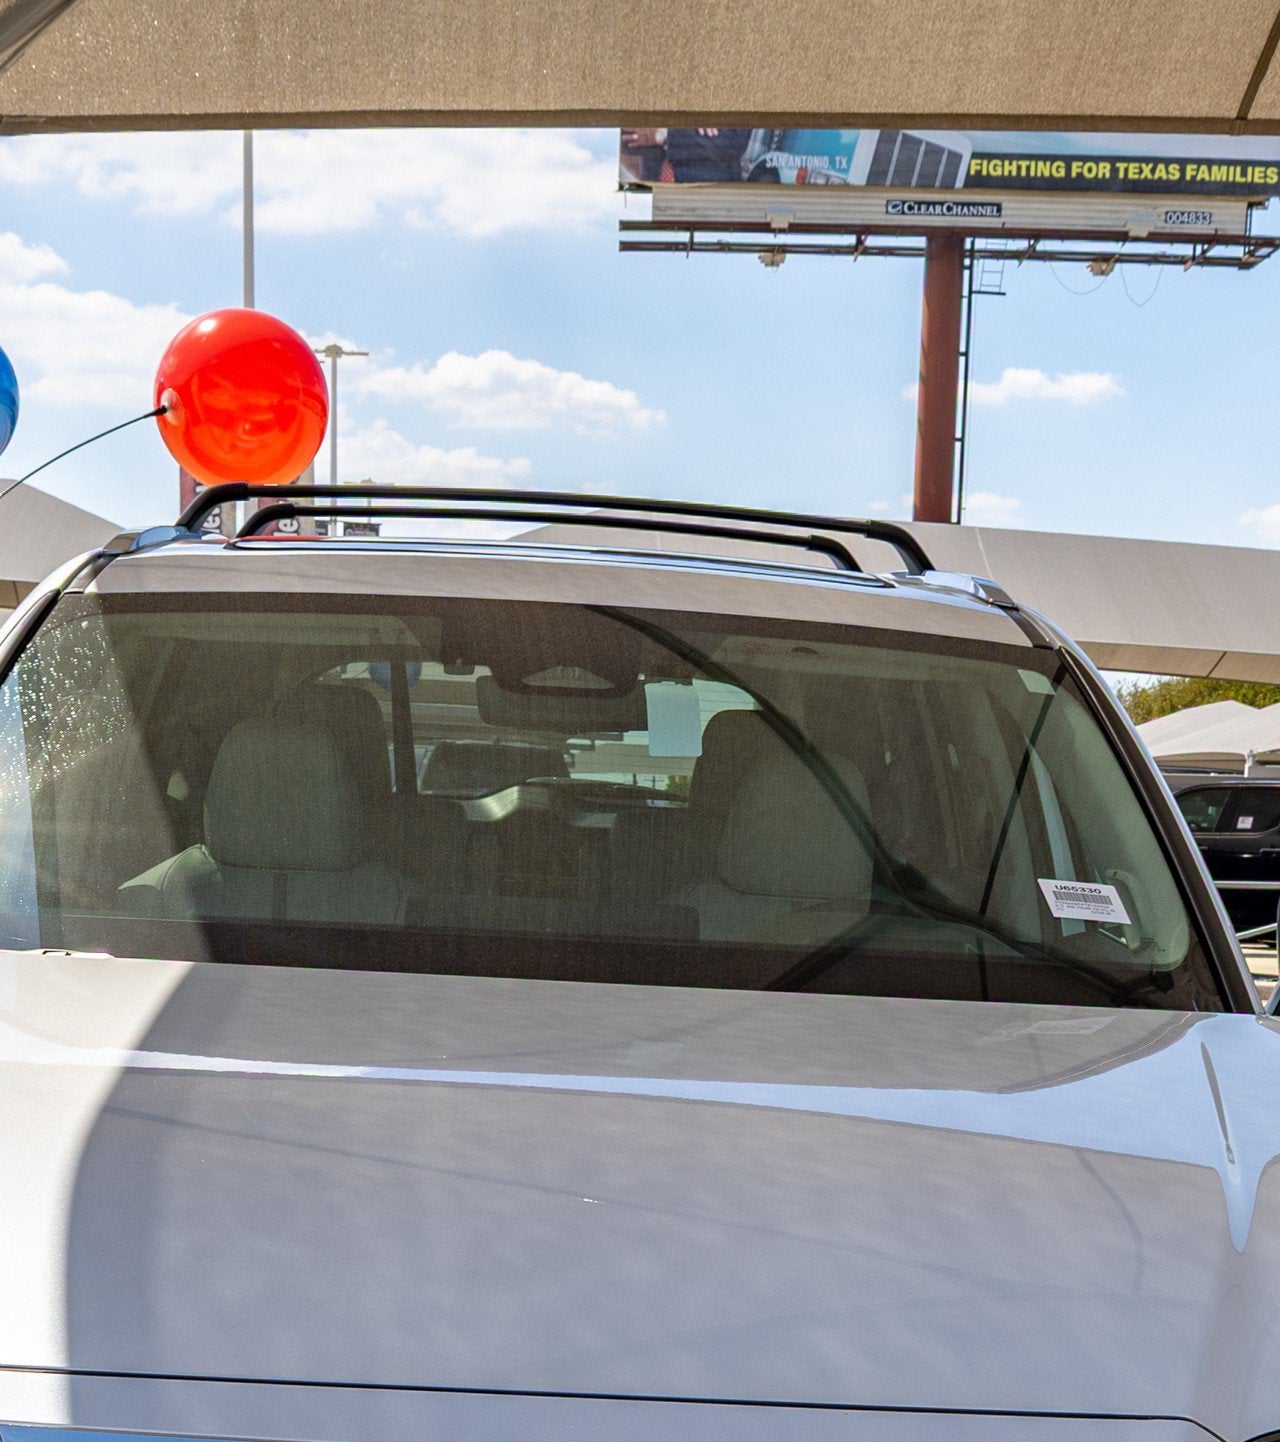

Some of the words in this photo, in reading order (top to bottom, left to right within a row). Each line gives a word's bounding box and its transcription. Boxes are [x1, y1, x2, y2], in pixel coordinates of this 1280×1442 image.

[835, 157, 848, 169] TX
[969, 159, 1066, 178] FIGHTING
[1070, 161, 1111, 179] FOR
[1115, 162, 1181, 180] TEXAS
[1185, 164, 1279, 184] FAMILIES
[1166, 212, 1212, 224] 004833
